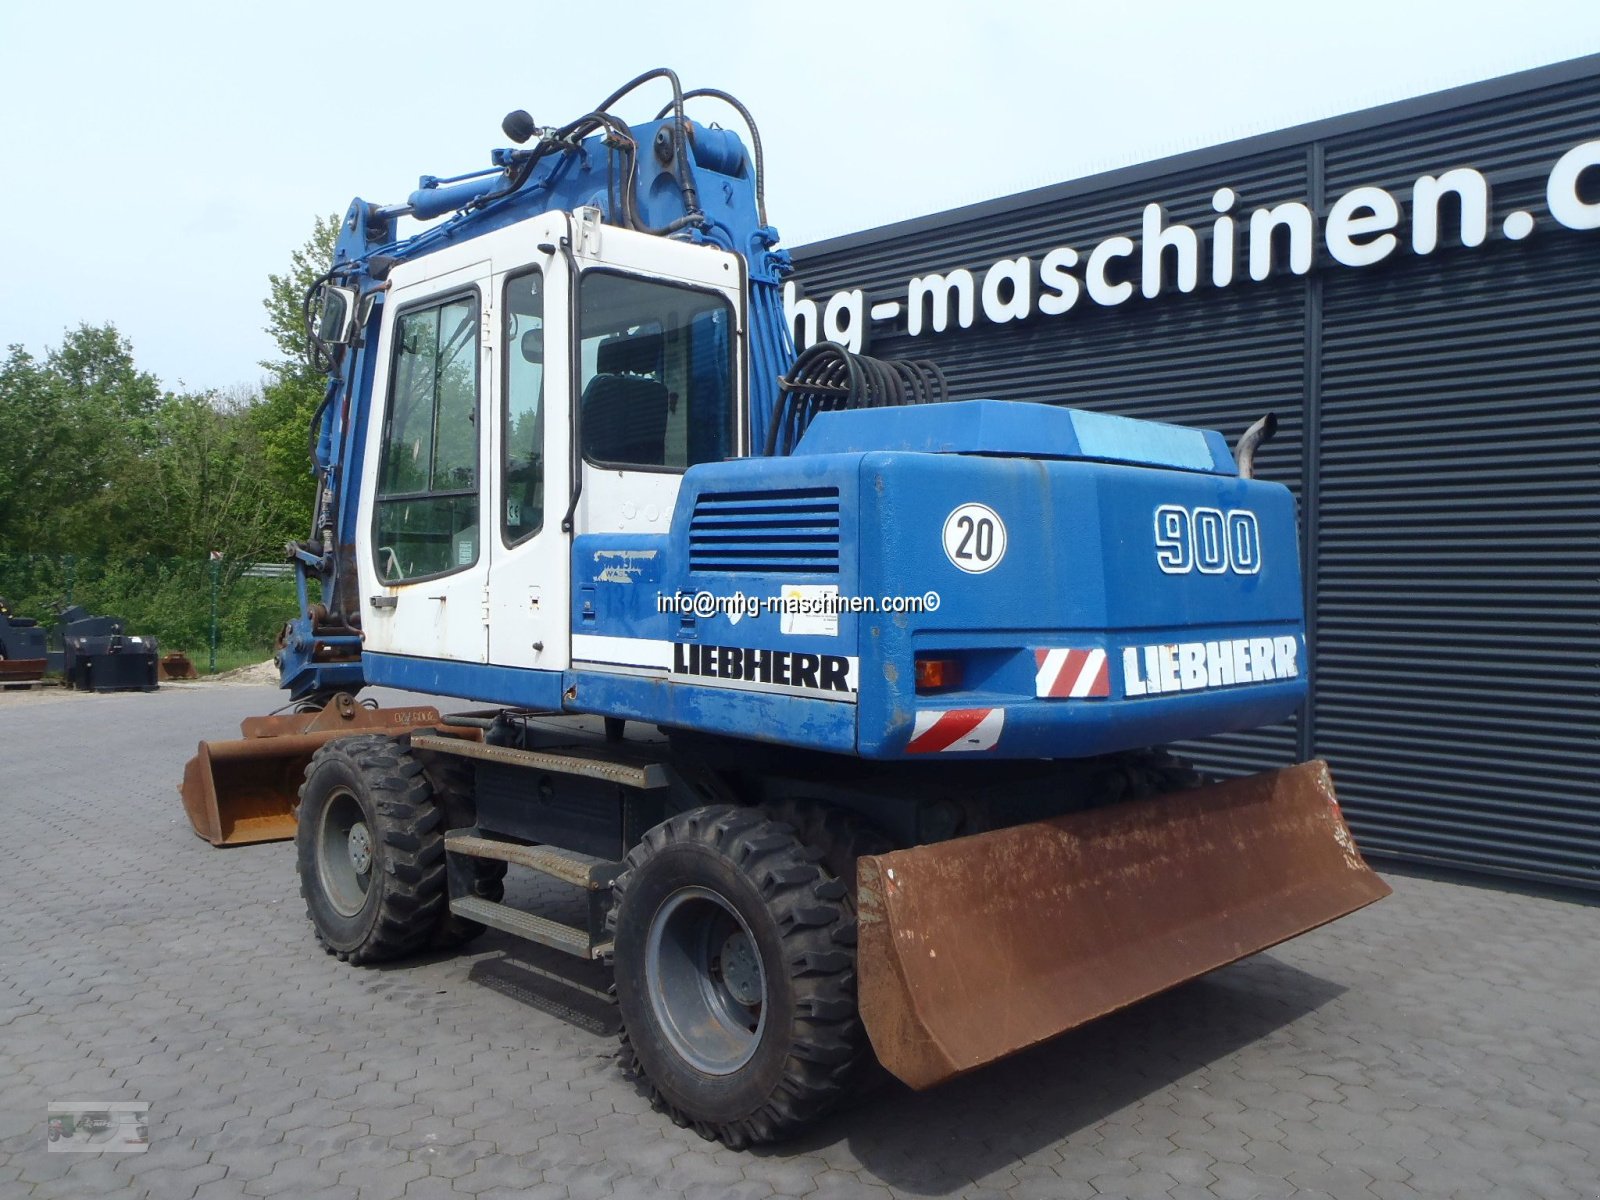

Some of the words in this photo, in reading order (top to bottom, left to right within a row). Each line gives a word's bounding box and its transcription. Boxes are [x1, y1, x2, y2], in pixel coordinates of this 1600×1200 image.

[955, 515, 994, 562] 20
[1154, 504, 1261, 575] 900
[674, 643, 849, 692] LIEBHERR
[1123, 636, 1299, 697] LIEBHERR
